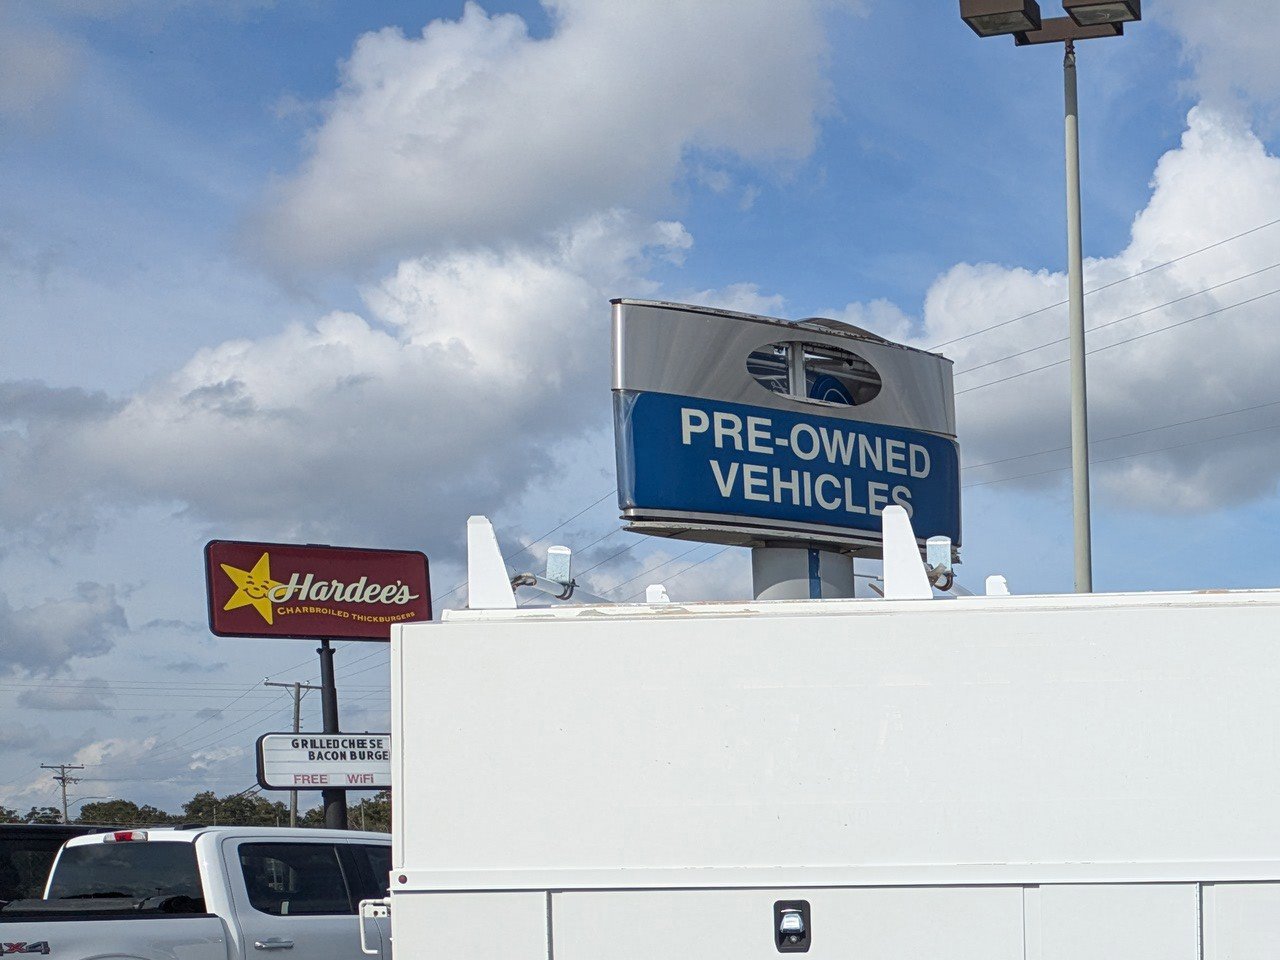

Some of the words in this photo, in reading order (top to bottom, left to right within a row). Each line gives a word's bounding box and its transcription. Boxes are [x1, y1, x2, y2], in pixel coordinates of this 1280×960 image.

[681, 407, 931, 479] PRE-OWNED
[709, 459, 914, 519] VEHICLES
[267, 572, 420, 605] Hardee's
[277, 606, 350, 619] CHARBROILED
[351, 611, 416, 623] THICKBURGERS
[291, 738, 340, 749] GRILLED
[341, 739, 383, 749] CHEESE
[308, 750, 347, 761] BACON
[293, 773, 328, 785] FREE
[346, 773, 375, 784] WiFi
[0, 941, 50, 956] X4
